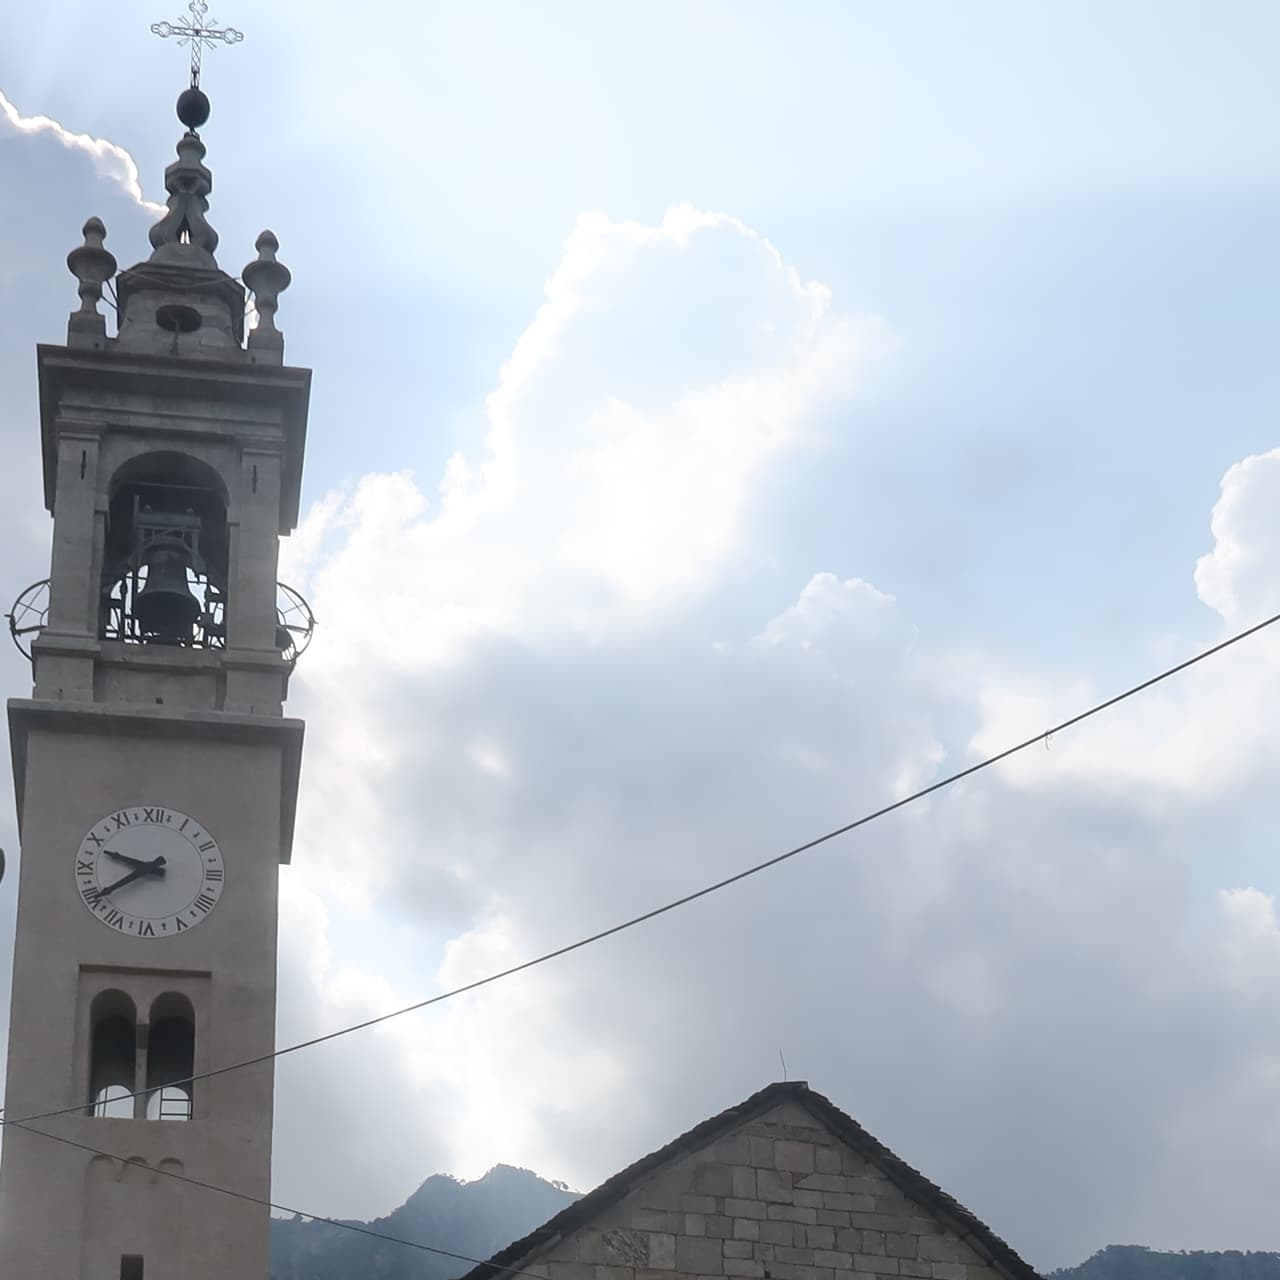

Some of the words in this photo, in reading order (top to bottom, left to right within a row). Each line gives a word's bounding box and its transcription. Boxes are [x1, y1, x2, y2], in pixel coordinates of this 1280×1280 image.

[111, 811, 131, 829] XI
[143, 808, 164, 823] XII
[179, 818, 189, 831] I
[86, 832, 104, 847] X
[198, 841, 216, 852] II
[77, 860, 94, 875] IX
[206, 869, 222, 882] III
[194, 894, 215, 913] IIII
[103, 909, 124, 929] VII
[175, 917, 189, 931] V
[138, 920, 155, 936] VI
